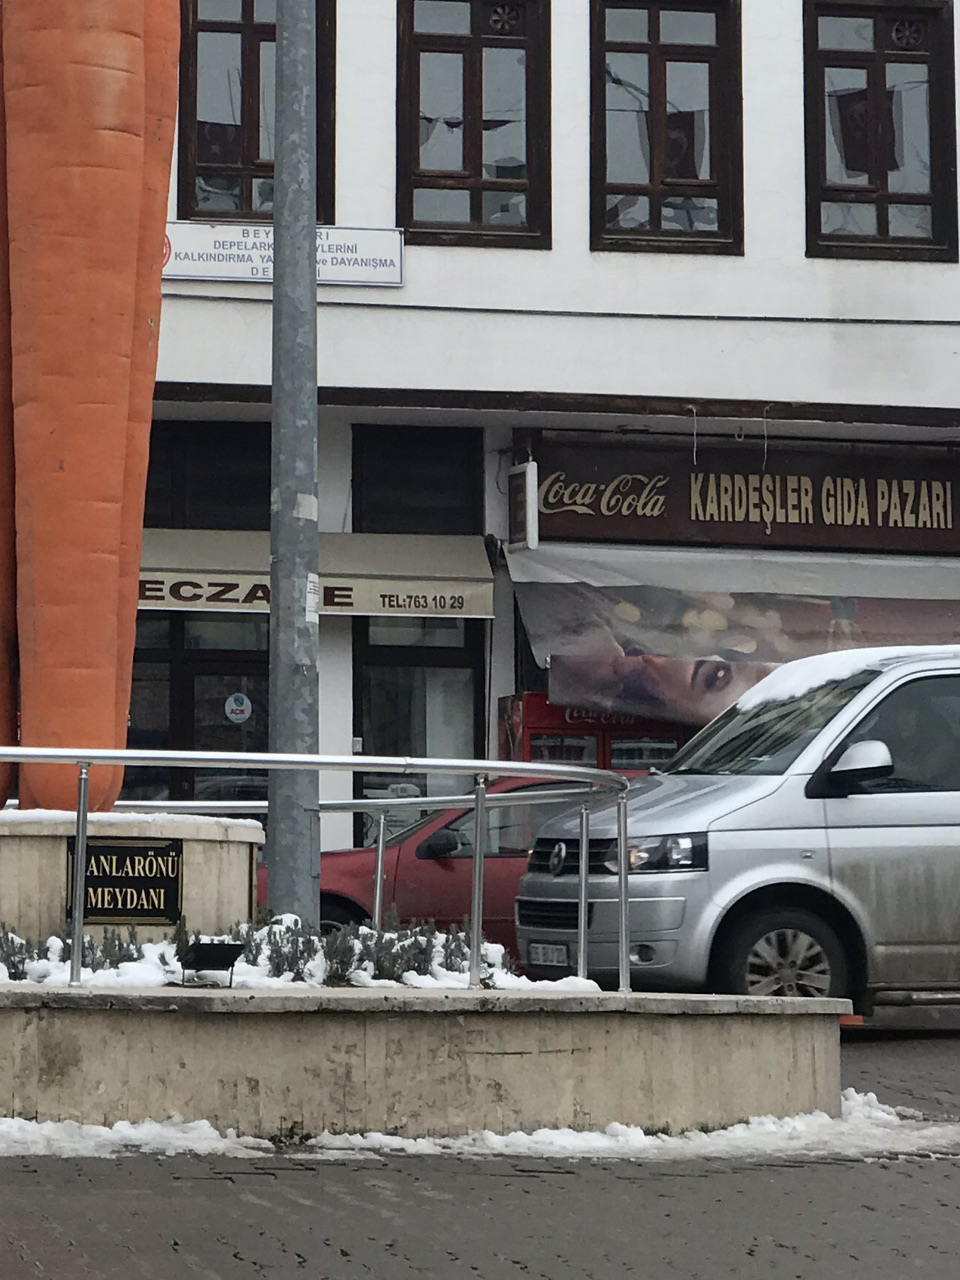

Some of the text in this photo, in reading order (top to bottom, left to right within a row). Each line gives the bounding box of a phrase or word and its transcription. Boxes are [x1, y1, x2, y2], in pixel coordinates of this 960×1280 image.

[213, 239, 358, 254] DEPELARK YLERİNİ
[174, 251, 254, 263] KALKINDIRMA
[330, 256, 396, 270] DAYANIŞMA
[538, 470, 670, 517] Coca-Cola
[689, 472, 954, 535] KARDEŞLER GIDA PAZARI
[138, 579, 354, 608] ECZAE
[379, 593, 465, 610] TEL:763 10 29
[86, 850, 178, 878] ANLARÖNÜ
[86, 886, 166, 910] MEYDANI
